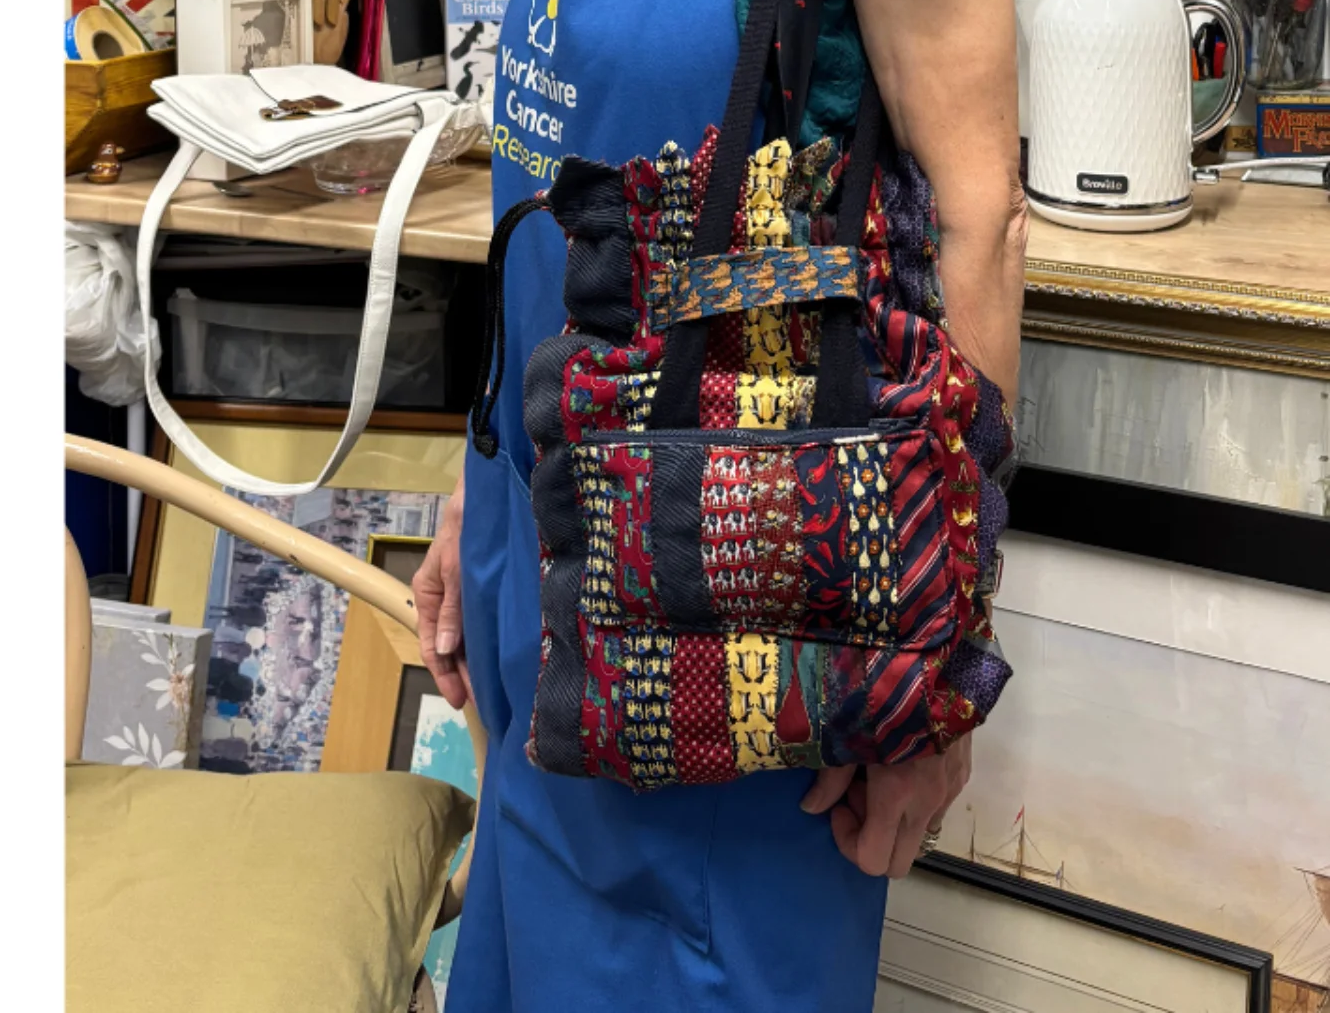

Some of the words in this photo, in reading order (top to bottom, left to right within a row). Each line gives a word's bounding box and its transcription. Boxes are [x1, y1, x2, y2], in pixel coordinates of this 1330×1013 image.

[462, 1, 504, 16] Birds
[501, 45, 577, 108] Yorkshire
[506, 90, 563, 144] Cancer
[492, 124, 563, 182] Researc
